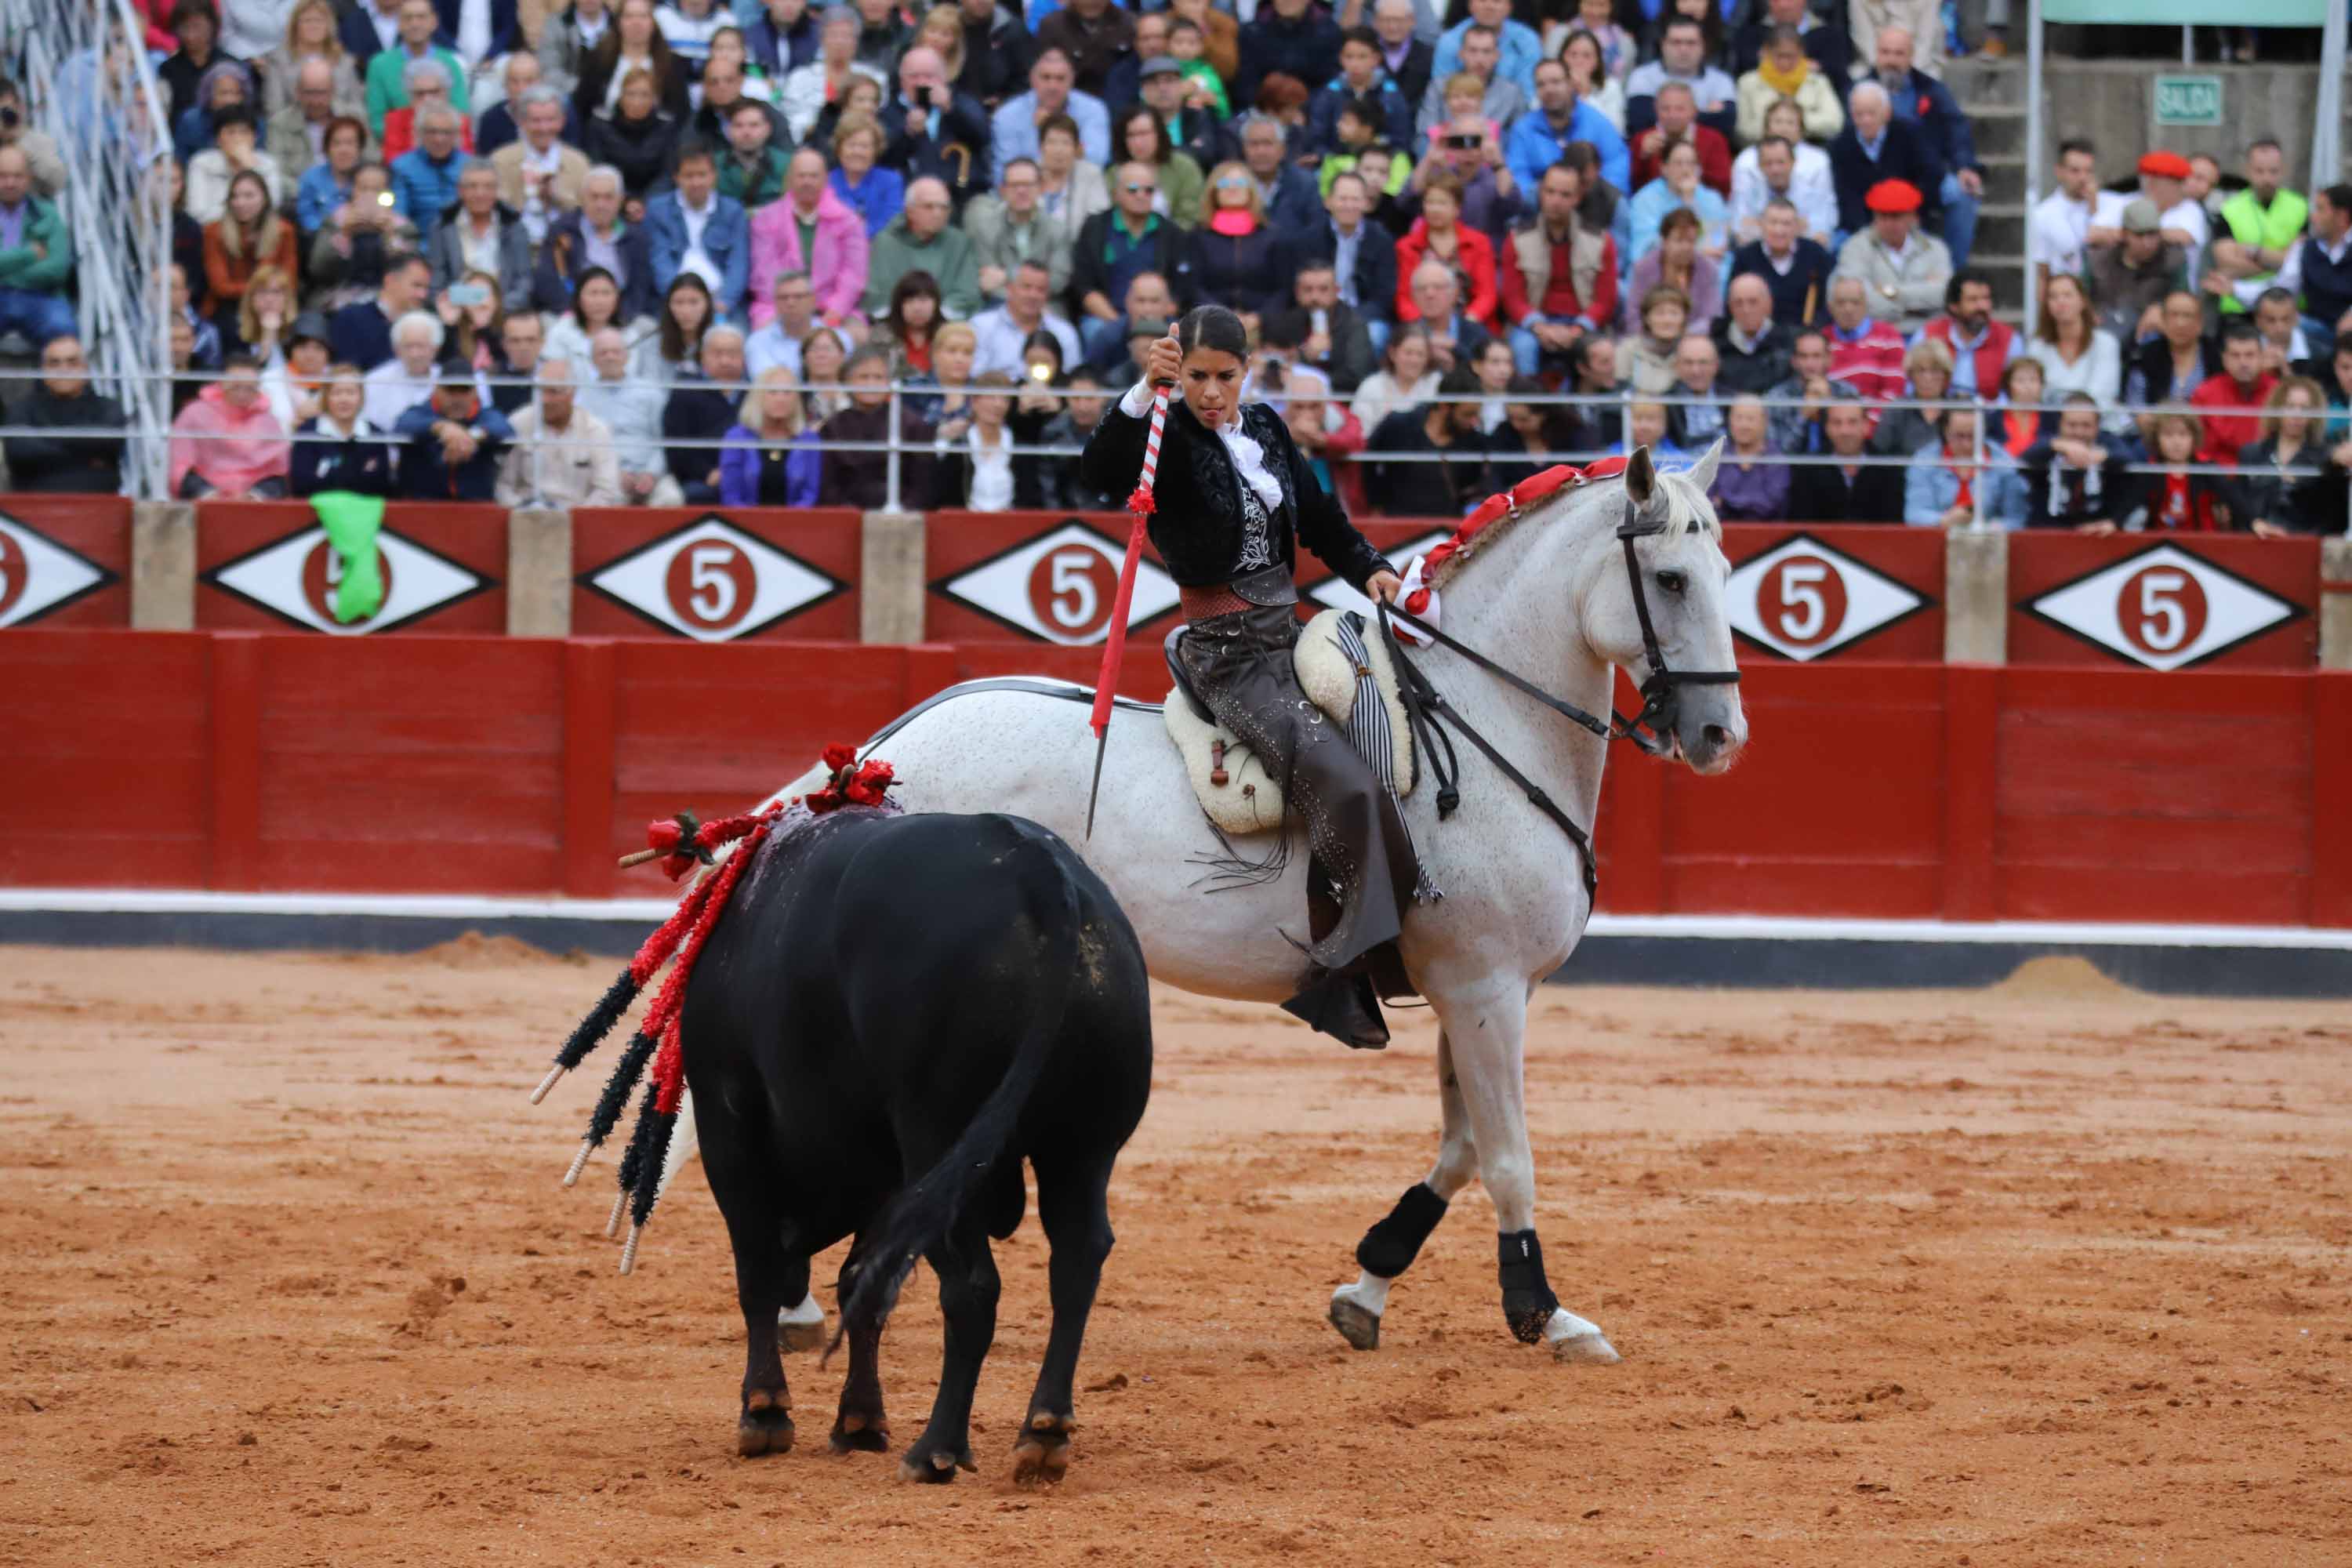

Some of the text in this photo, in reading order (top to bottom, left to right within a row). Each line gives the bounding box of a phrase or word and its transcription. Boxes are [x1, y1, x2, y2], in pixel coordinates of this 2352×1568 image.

[689, 546, 737, 622] 5
[1051, 552, 1098, 628] 5
[1780, 564, 1827, 641] 5
[2140, 573, 2187, 651] 5
